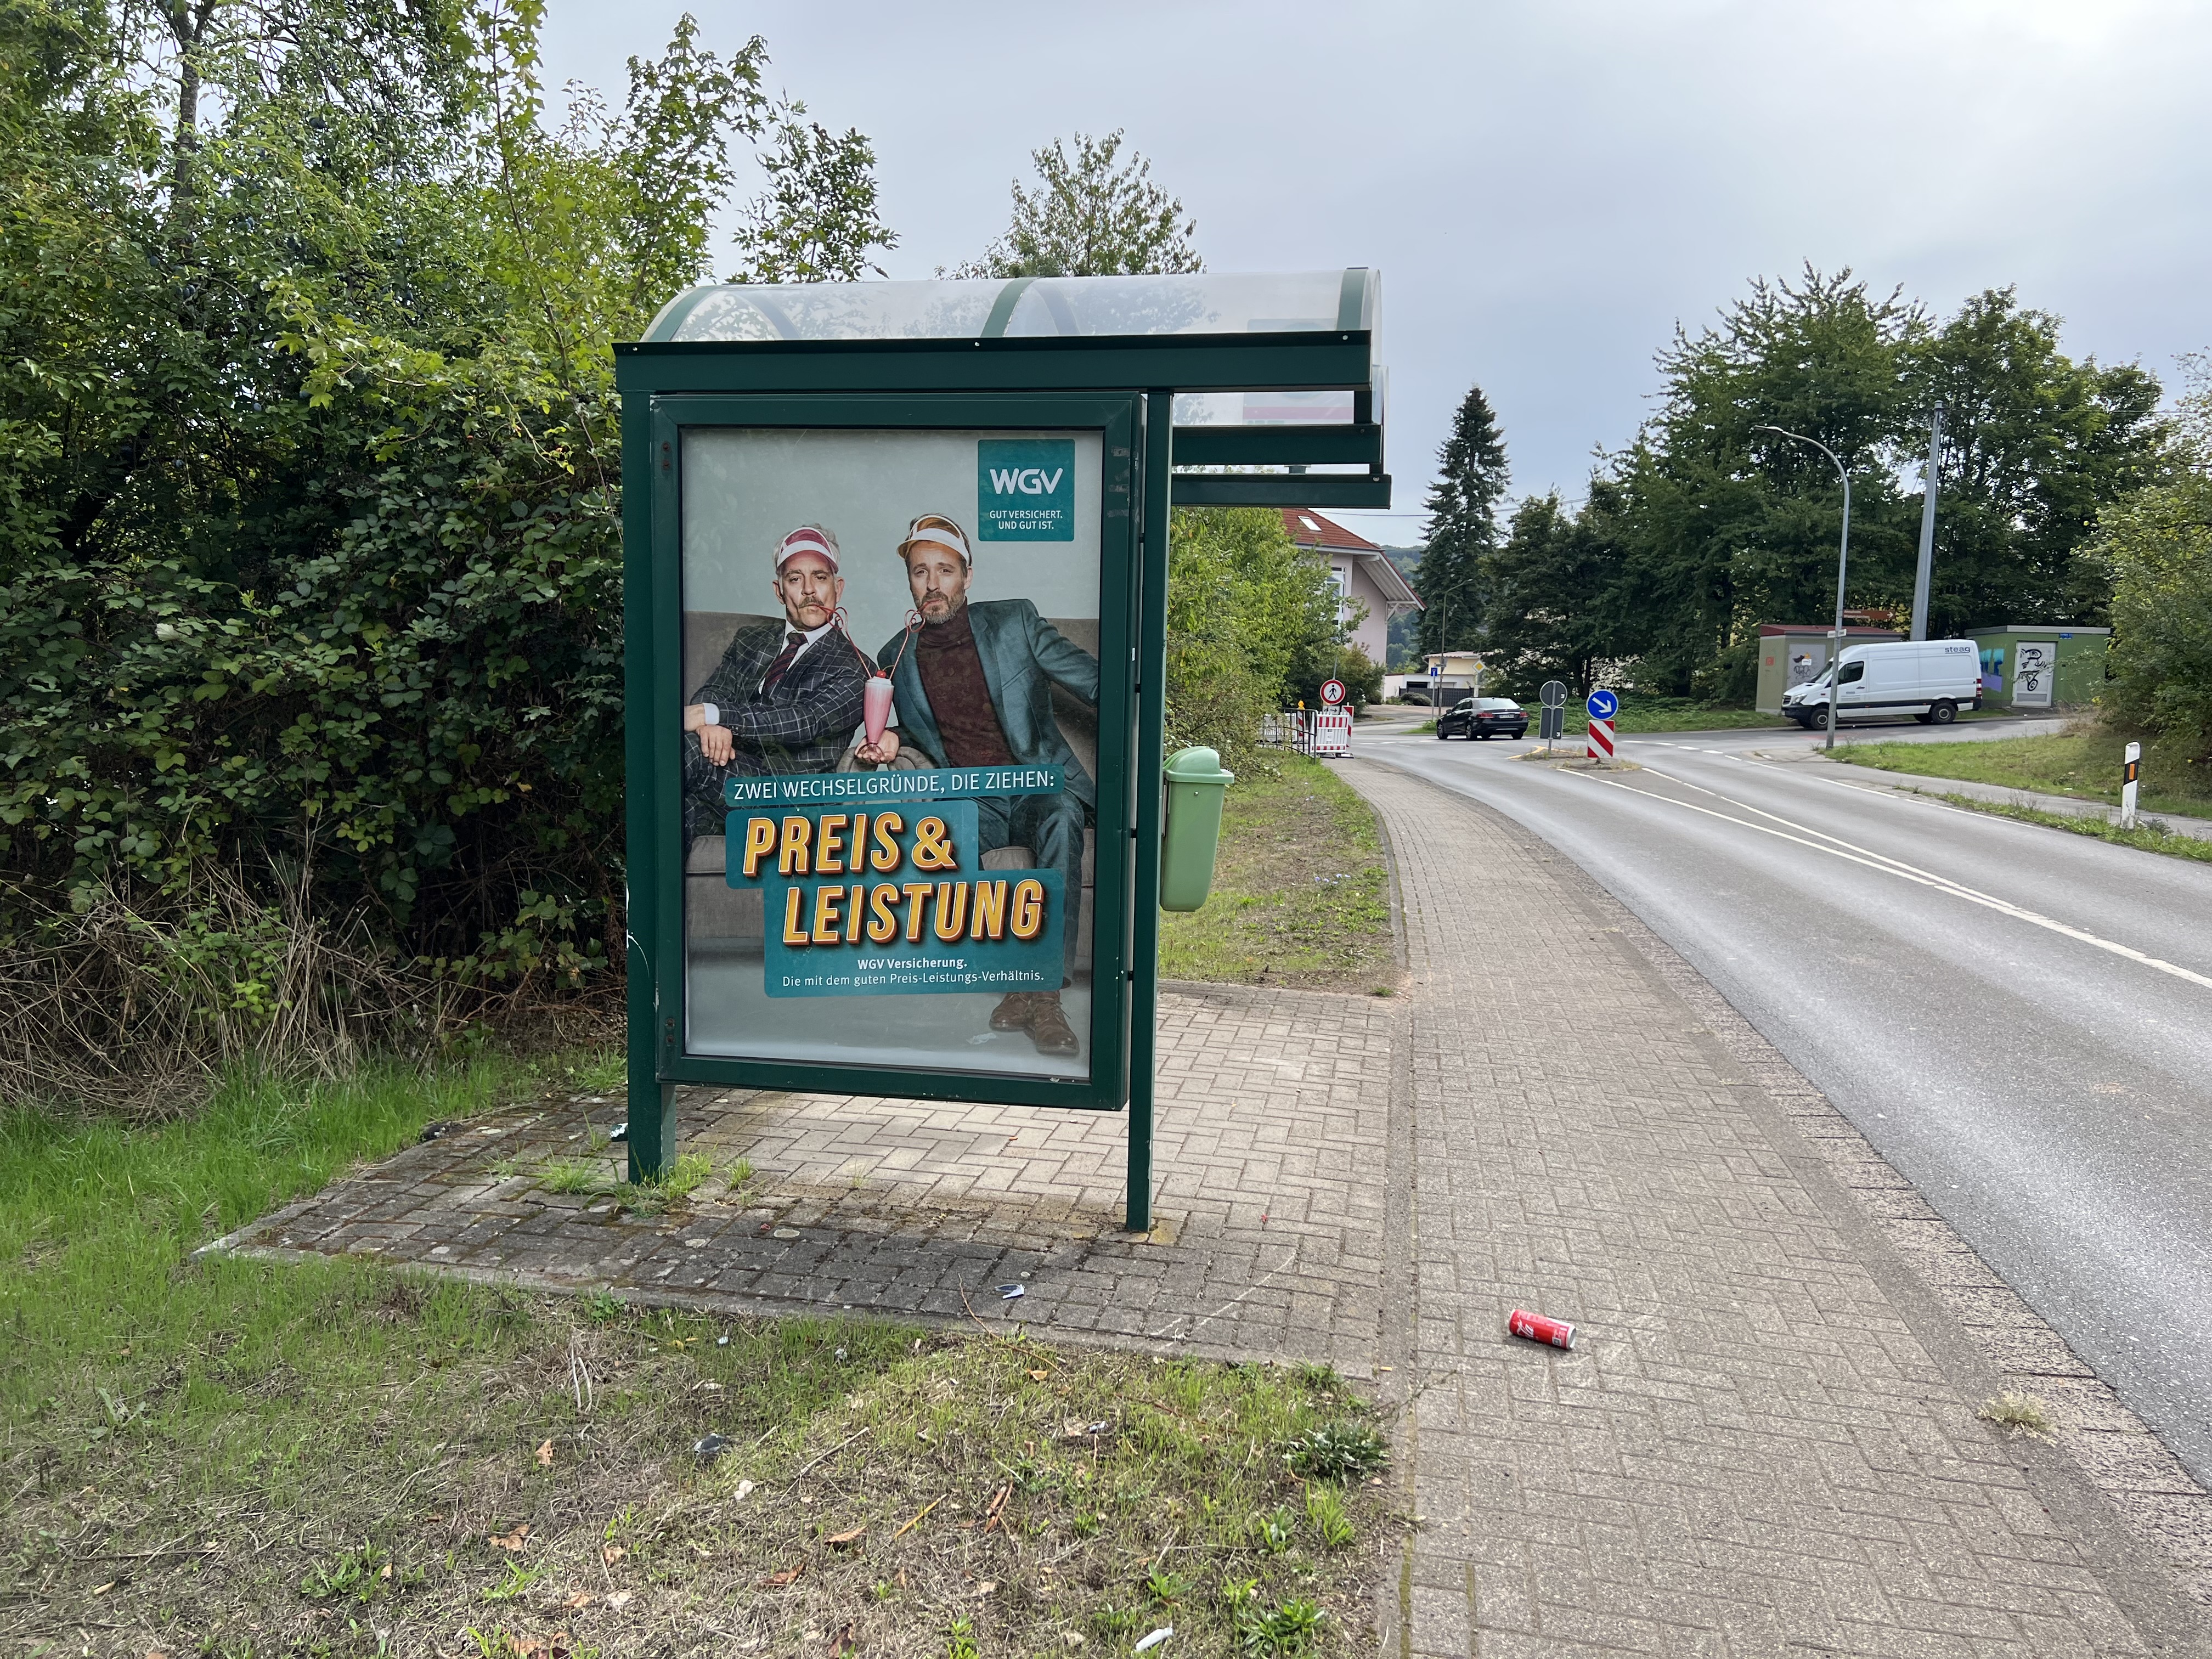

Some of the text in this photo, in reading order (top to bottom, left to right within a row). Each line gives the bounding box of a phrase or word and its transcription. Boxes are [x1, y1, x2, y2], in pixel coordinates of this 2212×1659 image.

[989, 467, 1063, 494] WGV
[989, 510, 1063, 518] GUT VERSICHERT.
[998, 521, 1054, 529] UND GUT IST.
[734, 770, 1054, 800] ZWEI WECHSELGRÜNDE, DIE ZIEHEN:
[742, 811, 958, 877] PREIS &
[782, 878, 1045, 946] LEISTUNG
[857, 957, 967, 970] WGV Versicherung.
[782, 969, 1045, 987] Die mit dem guten Preis-Leistungs-Verhältnis.
